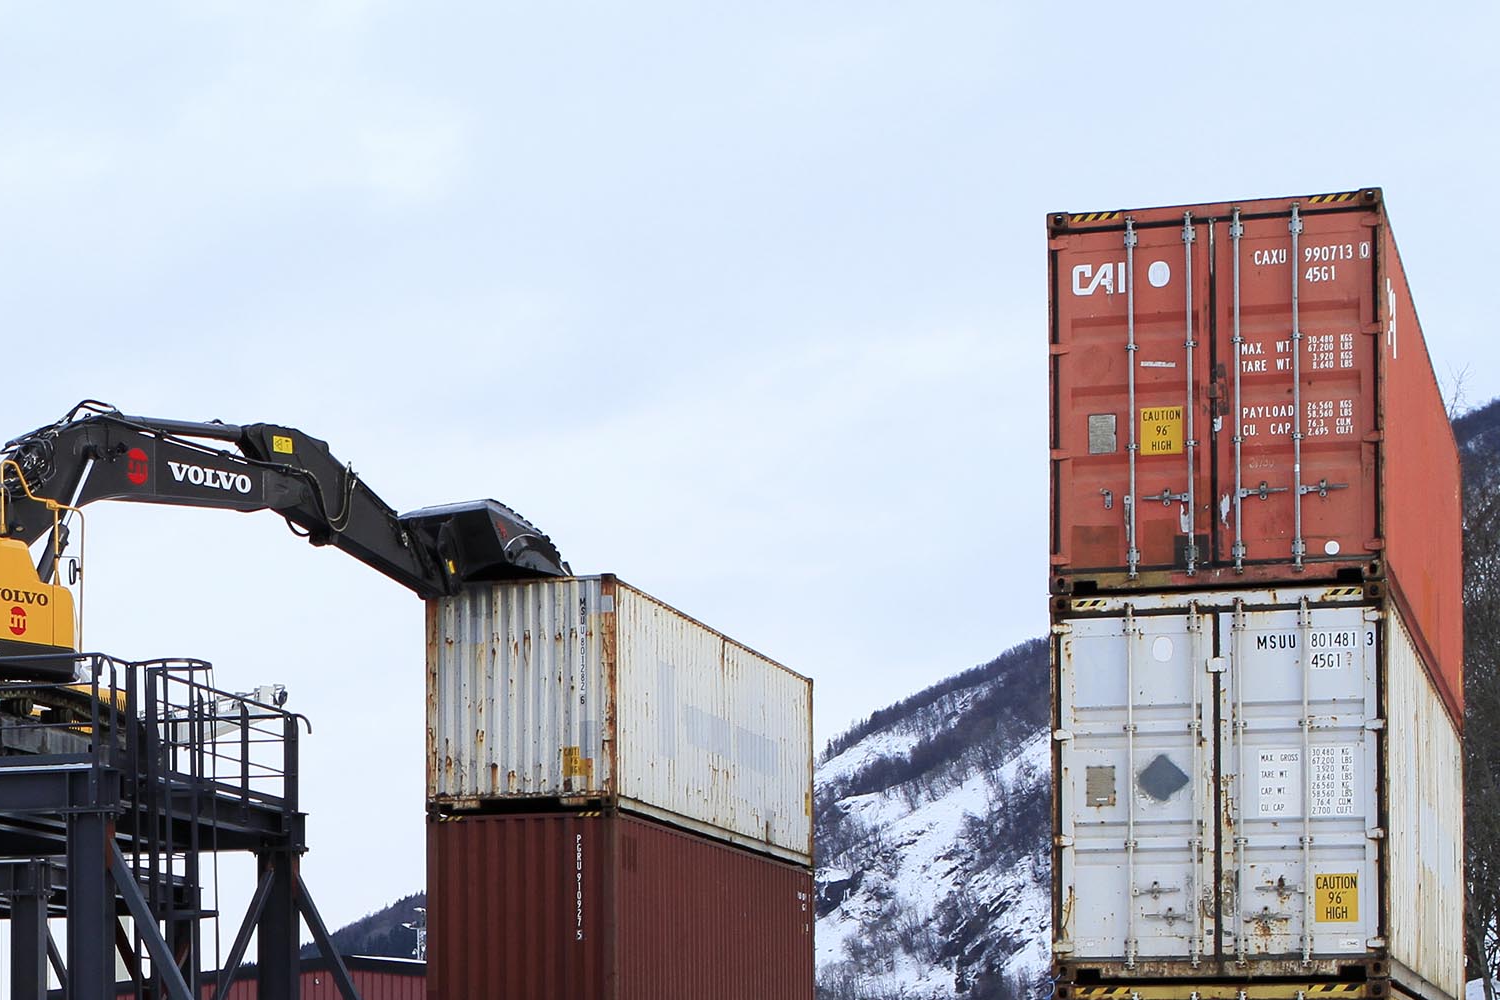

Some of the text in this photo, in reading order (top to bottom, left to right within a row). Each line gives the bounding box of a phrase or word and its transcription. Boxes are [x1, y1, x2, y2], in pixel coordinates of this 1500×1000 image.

[1254, 242, 1369, 265] CAXU 990713 0
[1072, 262, 1126, 296] CAI
[1305, 265, 1336, 282] 45G1
[1308, 334, 1353, 344] 30.480 KGS
[1241, 341, 1293, 355] MAX. WT.
[1308, 342, 1353, 352] 67.200 LBS
[1313, 351, 1353, 361] 3.920 KGS
[1242, 358, 1293, 372] TARE WT.
[1313, 360, 1353, 369] 8.640 LBS
[1308, 400, 1353, 410] 26.560 KGS
[1142, 410, 1181, 422] CAUTION
[1242, 405, 1294, 418] PAYLOAD
[1308, 408, 1353, 418] 58.560 LBS
[1243, 423, 1295, 436] CU. CAP.
[1308, 419, 1324, 428] 76.3
[1308, 427, 1329, 436] 2.695
[1151, 440, 1172, 451] HIGH
[167, 461, 252, 494] VOLVO
[1257, 631, 1374, 650] MSUU 801481 3
[1311, 653, 1340, 668] 45G1
[1280, 753, 1299, 762] GROSS
[1341, 756, 1353, 764] LBS
[1315, 876, 1357, 890] CAUTION
[1325, 906, 1348, 919] HIGH
